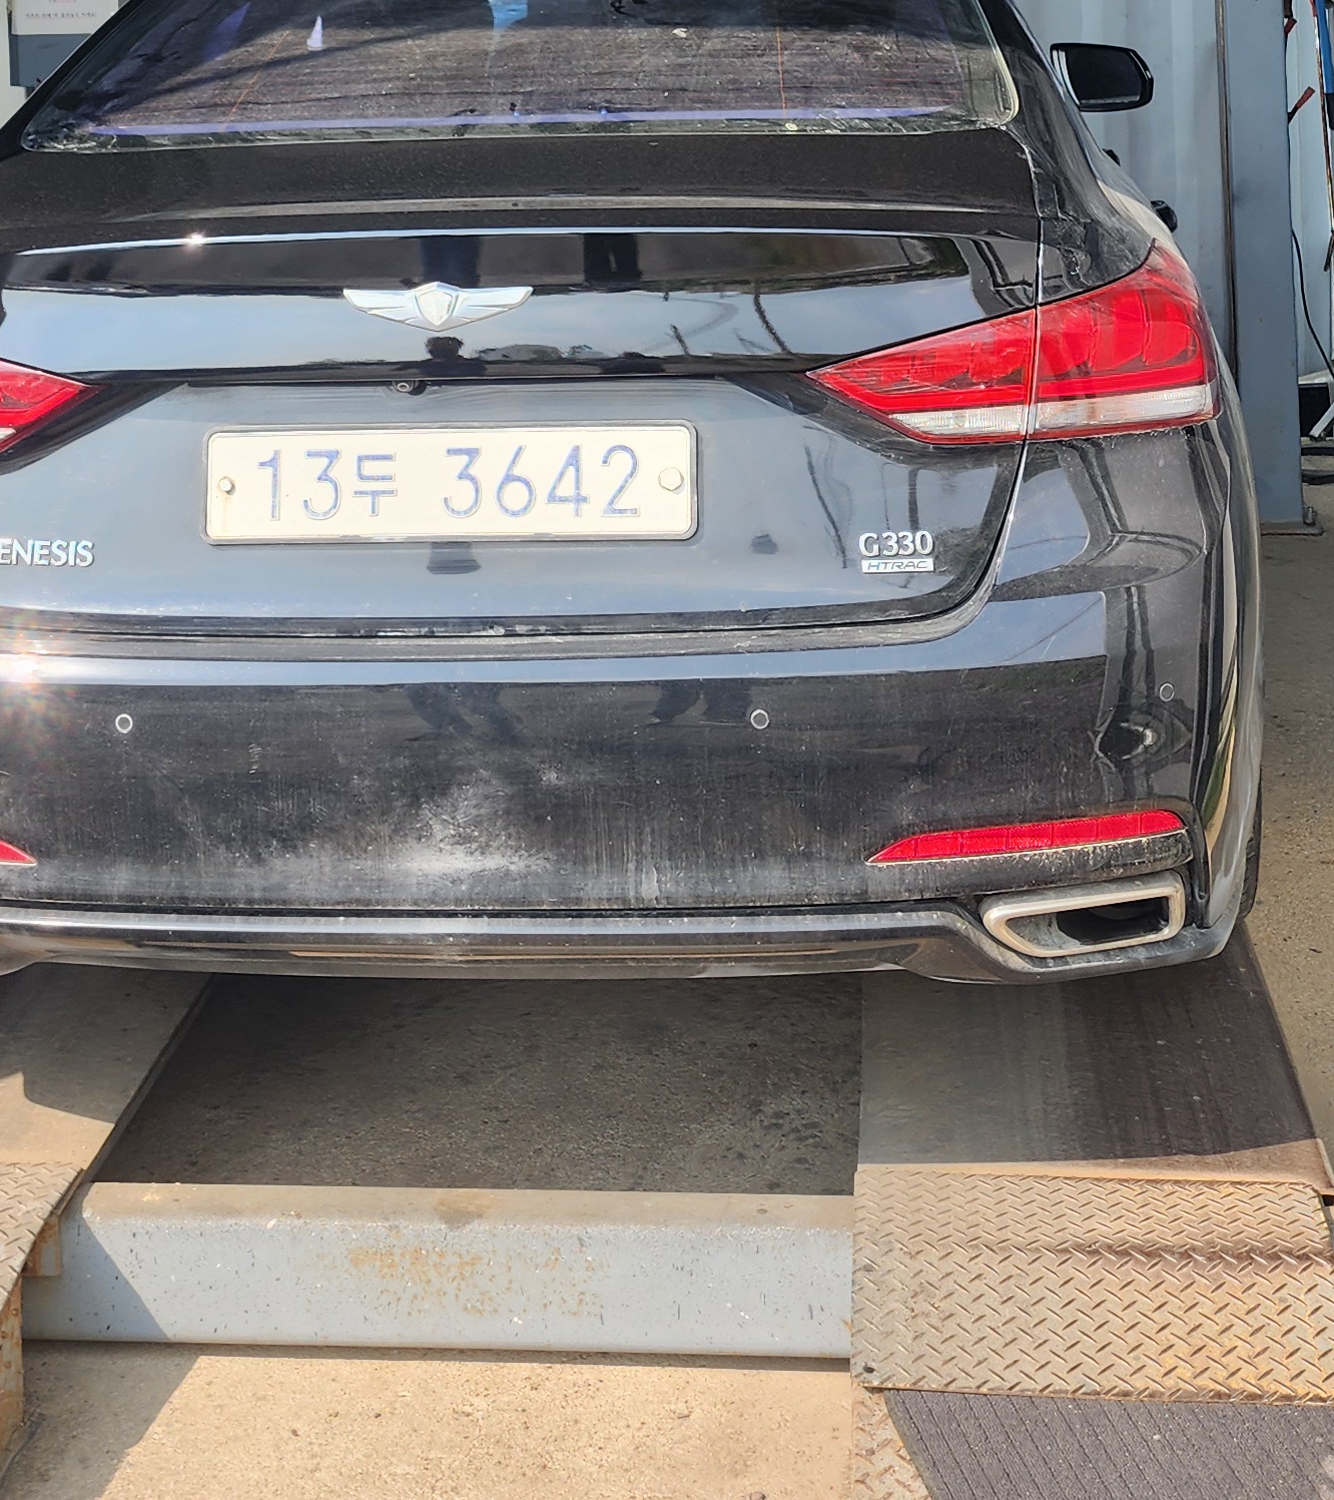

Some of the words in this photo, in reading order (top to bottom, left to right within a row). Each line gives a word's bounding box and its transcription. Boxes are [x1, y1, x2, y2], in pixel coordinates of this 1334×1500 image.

[255, 446, 397, 522] 13두
[442, 443, 642, 518] 3642
[858, 530, 934, 557] G330
[867, 560, 928, 570] HTRAC
